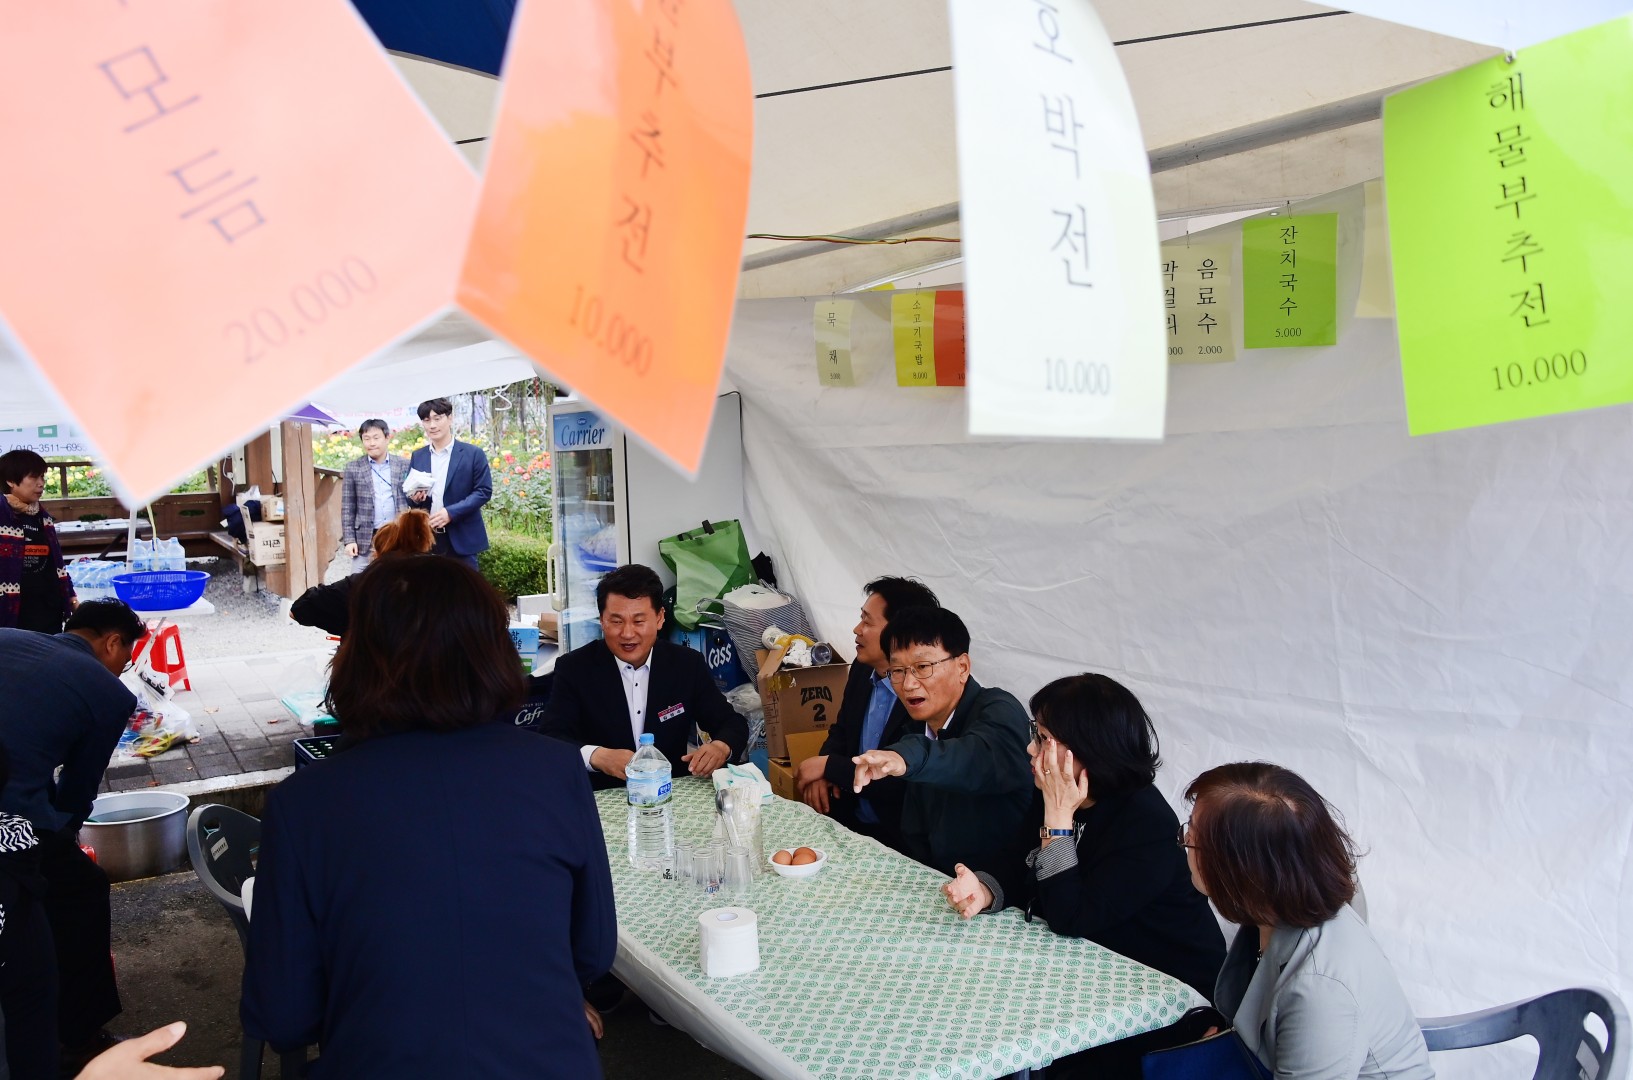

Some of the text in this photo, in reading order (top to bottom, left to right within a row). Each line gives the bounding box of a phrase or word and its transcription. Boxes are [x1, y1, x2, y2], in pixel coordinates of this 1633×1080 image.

[1484, 72, 1551, 328] 해물부추전
[1279, 225, 1298, 317] 잔치국수
[223, 254, 379, 365] 20.000
[1197, 258, 1218, 335] 음료수
[568, 285, 655, 378] 10.000
[912, 300, 924, 366] 소고기국밥
[1198, 345, 1223, 355] 2.000
[1274, 327, 1302, 338] 5.000
[1044, 357, 1110, 397] 10.000
[1492, 349, 1588, 391] 10.000
[561, 424, 605, 446] Carrier
[708, 642, 732, 670] Cass
[514, 707, 545, 725] Cafr
[800, 685, 833, 707] ZERO
[812, 704, 827, 722] 2
